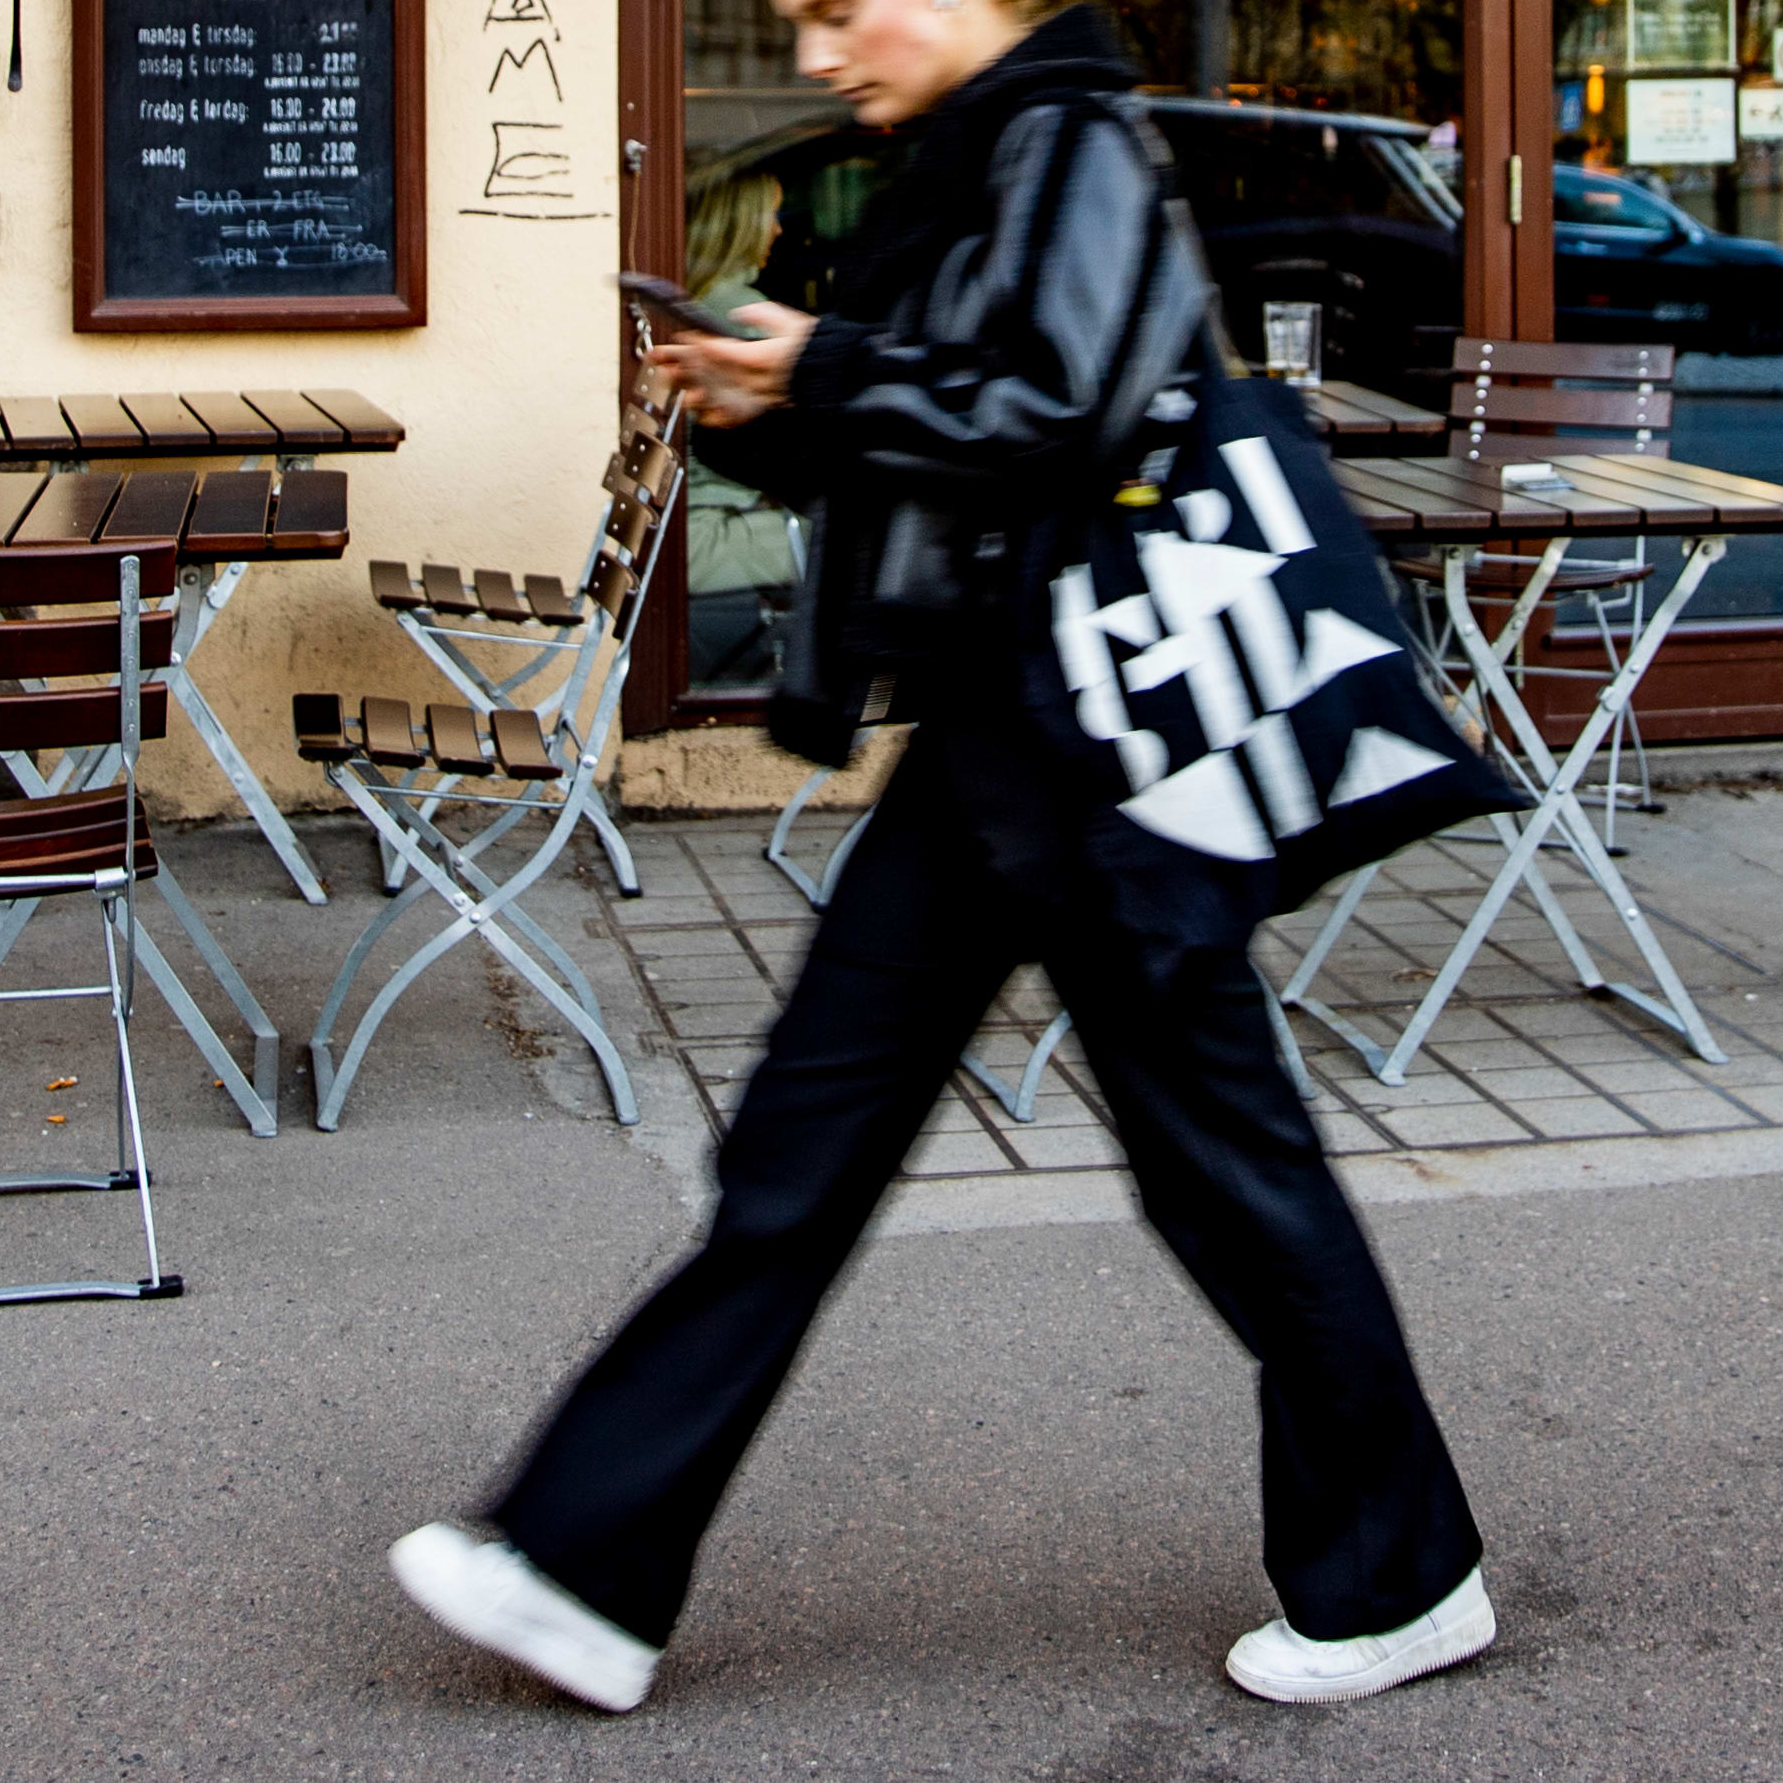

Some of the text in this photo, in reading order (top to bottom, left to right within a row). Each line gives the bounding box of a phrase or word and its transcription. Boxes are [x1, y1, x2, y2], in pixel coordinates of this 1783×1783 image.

[138, 24, 187, 48] mandag
[138, 55, 183, 78] onsdag
[140, 99, 184, 124] fredag
[142, 145, 187, 170] søndag
[293, 218, 331, 241] FRA
